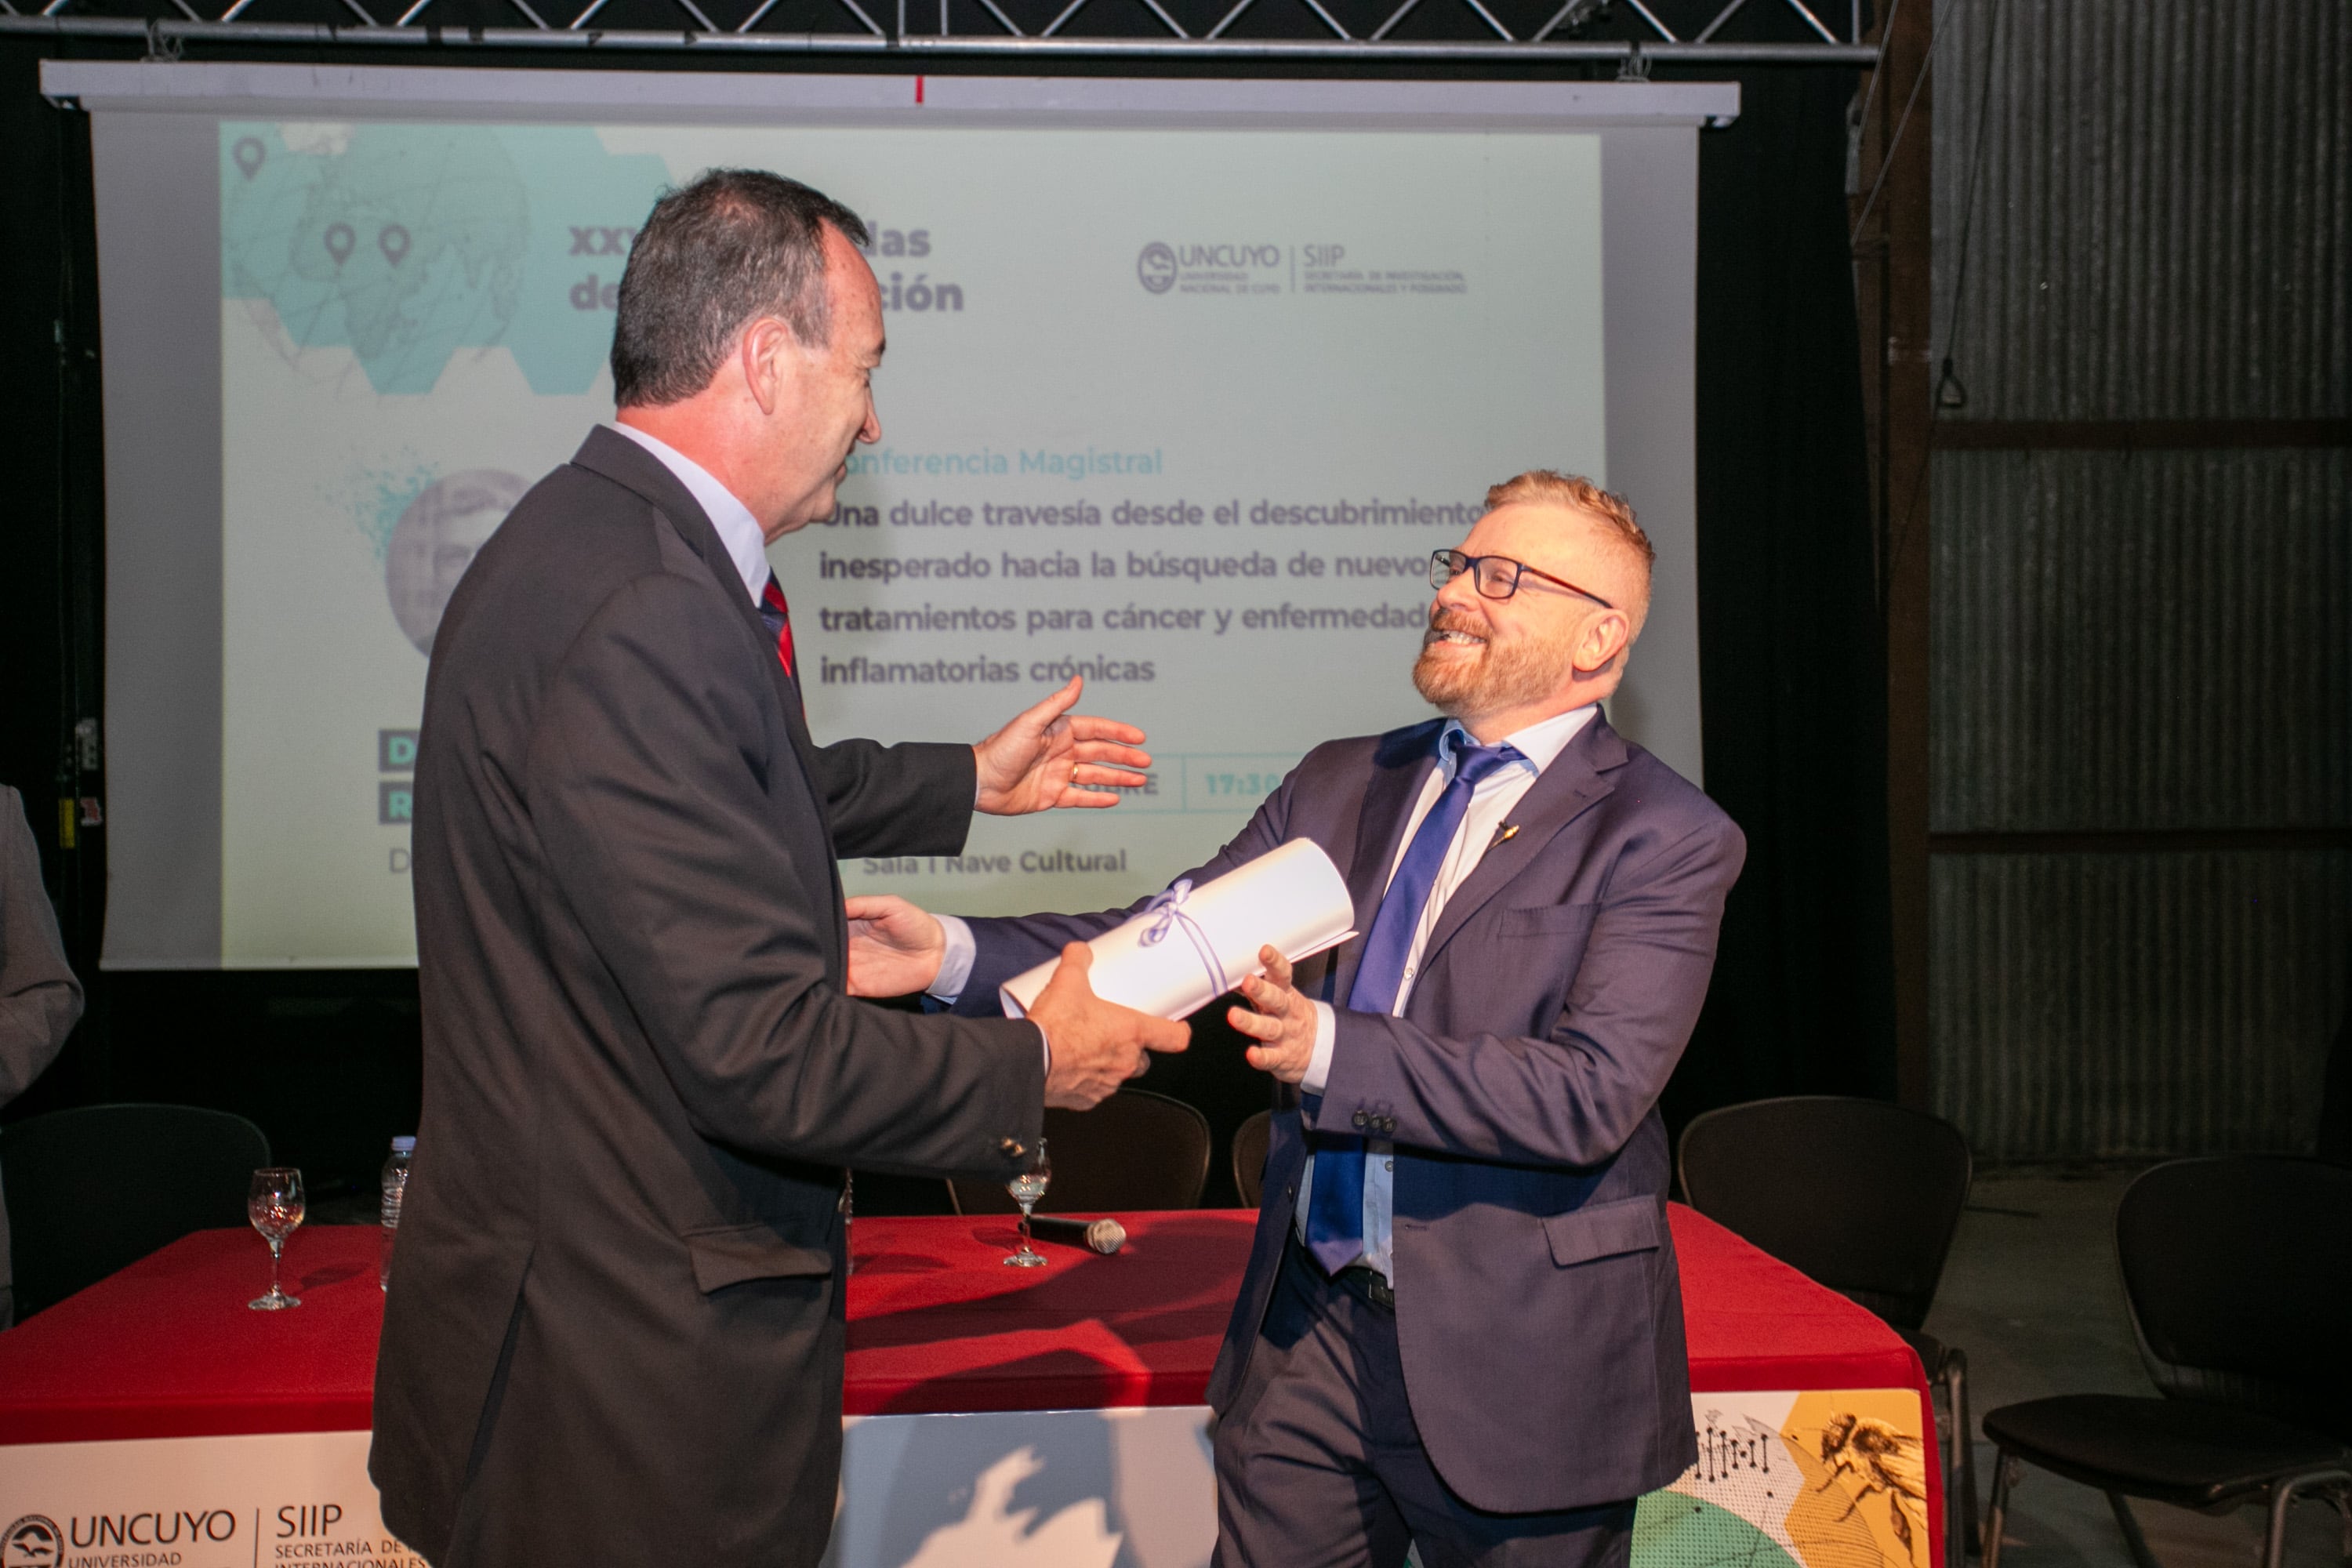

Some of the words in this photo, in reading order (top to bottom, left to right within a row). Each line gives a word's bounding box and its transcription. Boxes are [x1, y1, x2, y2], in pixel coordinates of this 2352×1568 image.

[1178, 245, 1280, 267] UNCUYO
[1304, 245, 1345, 267] SIIP
[844, 448, 1008, 475] onferencia
[1020, 447, 1163, 481] Magistral
[823, 503, 880, 527] Una
[890, 499, 974, 527] dulce
[982, 499, 1100, 527] travesía
[1112, 499, 1204, 527] desde
[1214, 500, 1240, 526] el
[1250, 498, 1485, 527] descubrimiento
[819, 552, 991, 584] inesperado
[1001, 552, 1080, 579] hacia
[1091, 552, 1116, 579] la
[1127, 550, 1278, 584] búsqueda
[1287, 551, 1325, 579] de
[1336, 555, 1428, 578] nuevo
[819, 604, 1016, 632] tratamientos
[1027, 608, 1093, 636] para
[1103, 603, 1204, 630] cáncer
[1213, 609, 1233, 635] y
[1242, 602, 1428, 630] enfermedad
[819, 656, 1020, 685] inflamatorias
[1029, 654, 1156, 684] crónicas
[863, 856, 918, 876] Sala
[945, 852, 1012, 873] Nave
[1020, 849, 1127, 873] Cultural
[71, 1509, 235, 1548] UNCUYO
[277, 1504, 343, 1538] SIIP
[68, 1552, 182, 1568] UNIVERSIDAD
[275, 1538, 372, 1559] SECRETARÍA
[381, 1540, 403, 1554] DE
